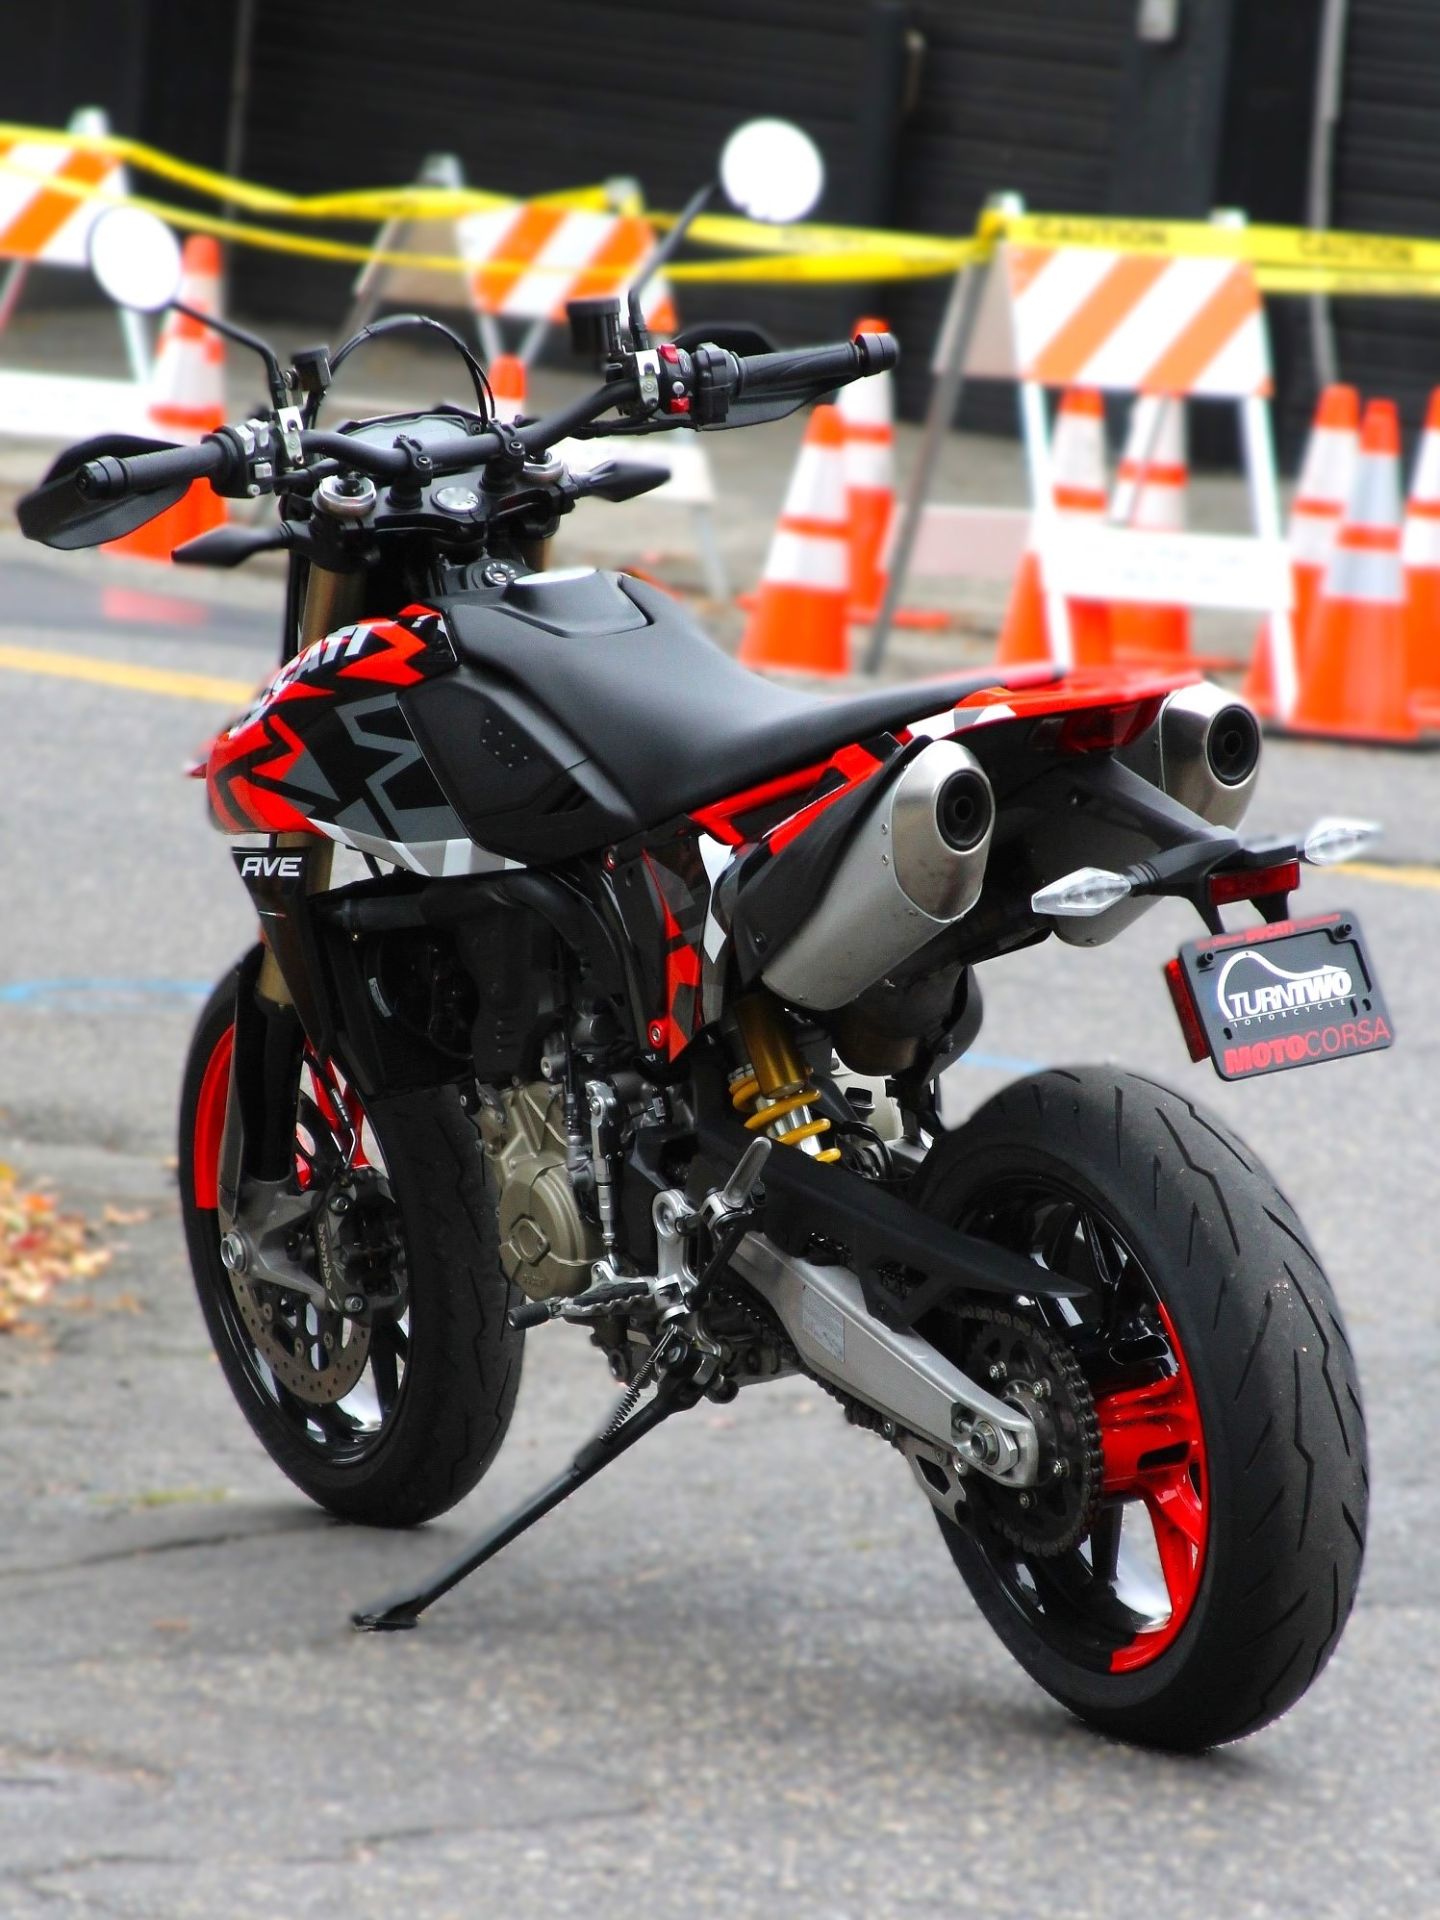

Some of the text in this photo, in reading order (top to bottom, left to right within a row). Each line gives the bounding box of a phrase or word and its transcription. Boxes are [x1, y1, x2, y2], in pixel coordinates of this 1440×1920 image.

[1034, 220, 1168, 246] CAUTION
[1297, 231, 1413, 262] CAUTION
[1228, 971, 1353, 1018] TURNTWO
